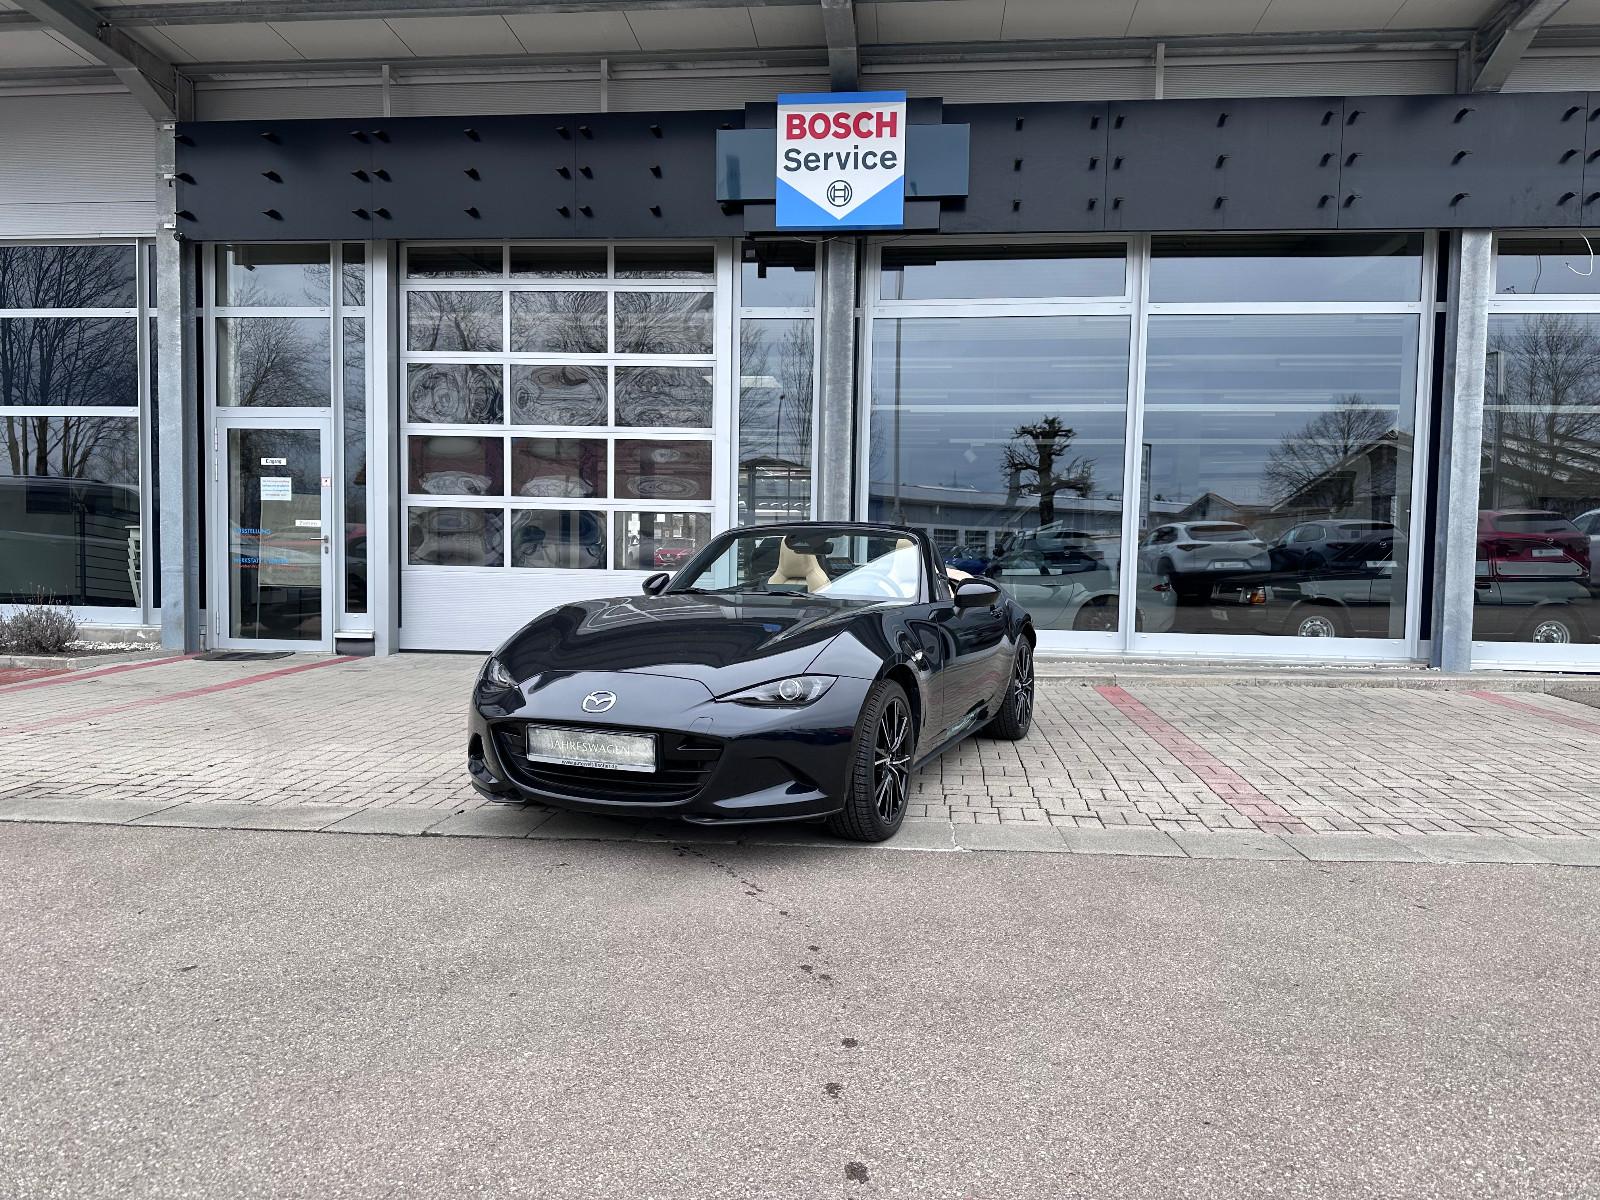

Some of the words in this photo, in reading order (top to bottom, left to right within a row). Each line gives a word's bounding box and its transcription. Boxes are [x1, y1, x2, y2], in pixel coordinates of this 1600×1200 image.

[786, 111, 898, 140] BOSCH
[783, 144, 898, 172] Service
[550, 739, 630, 757] JAHRESWAGEN
